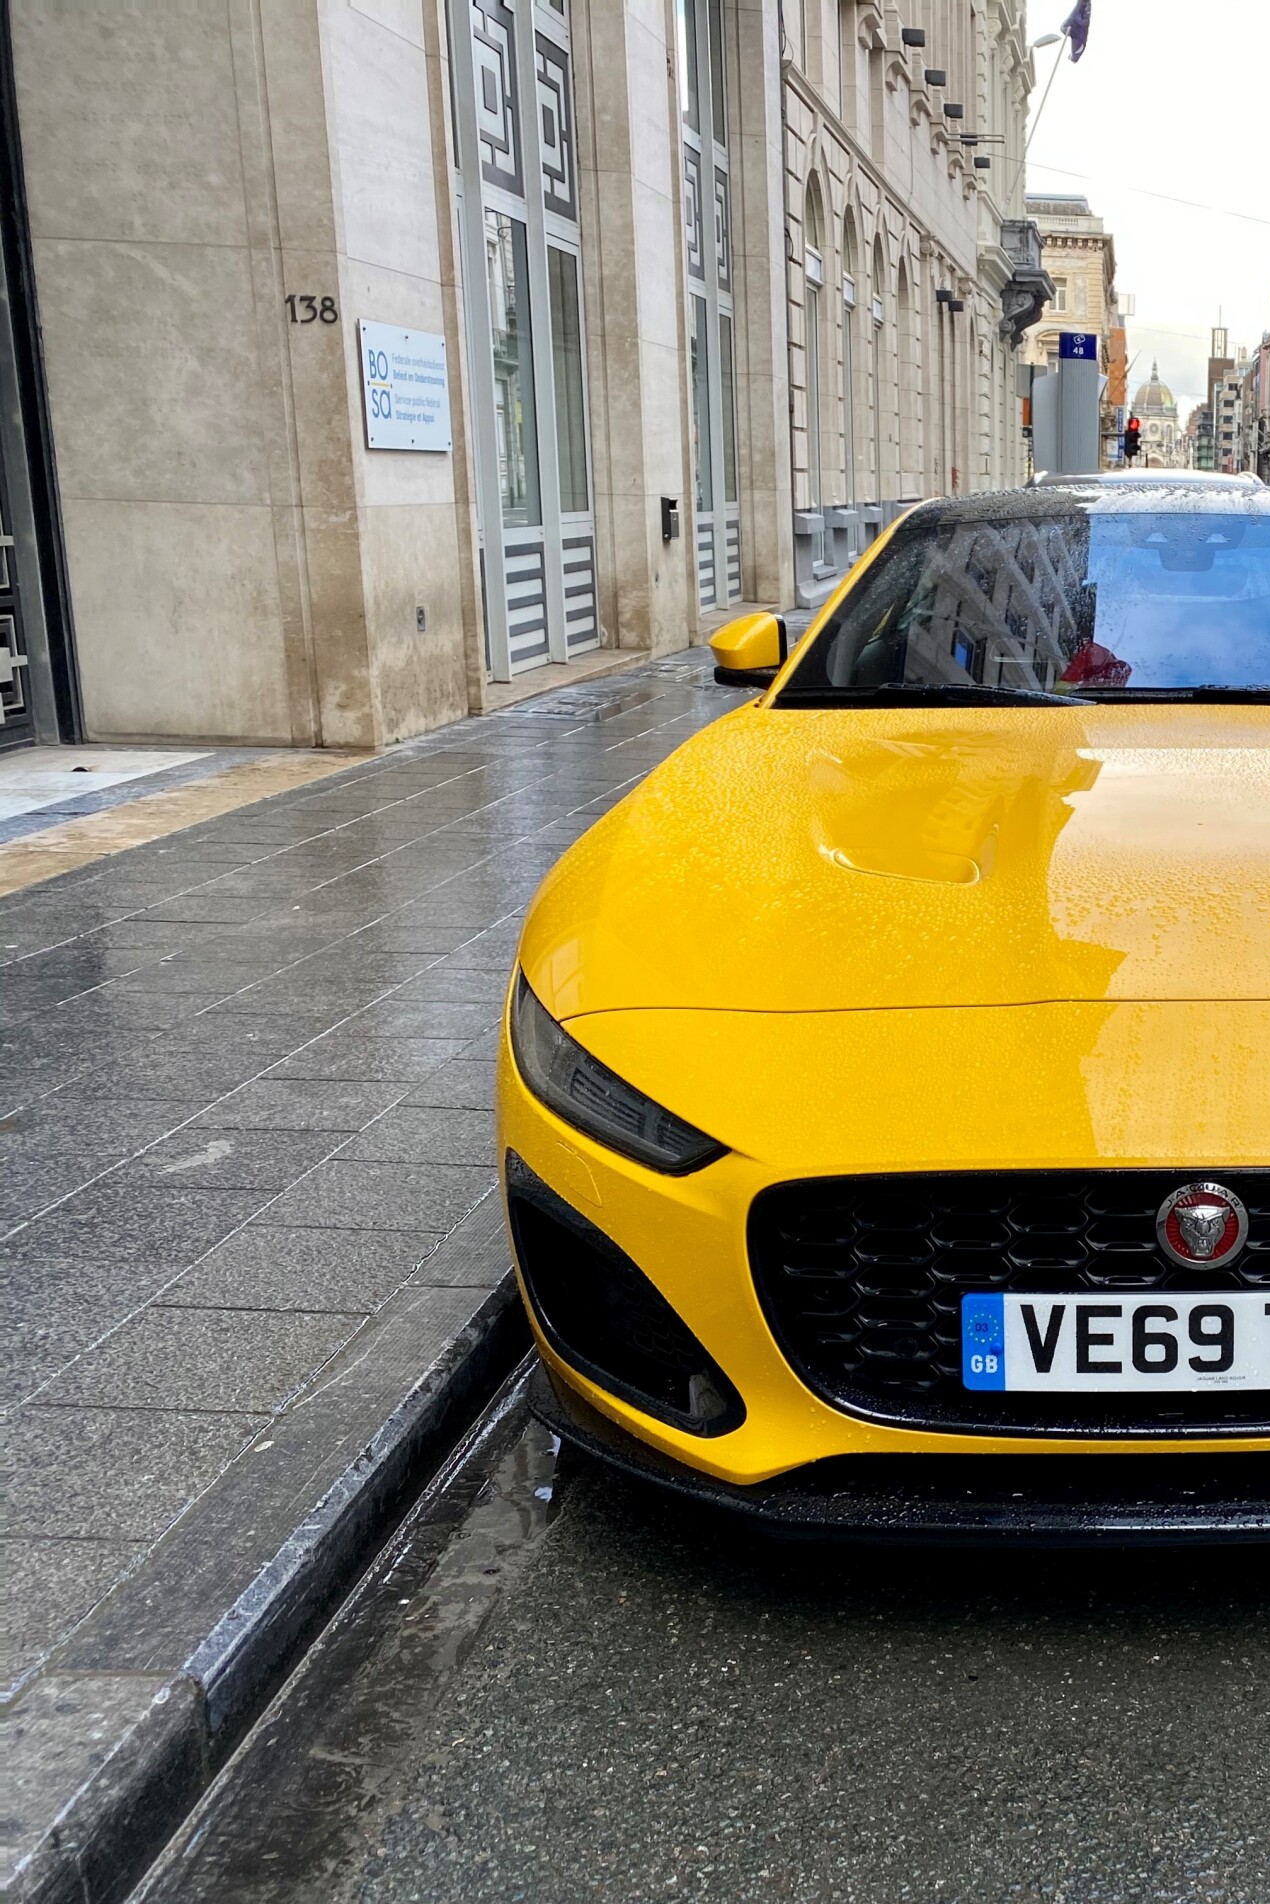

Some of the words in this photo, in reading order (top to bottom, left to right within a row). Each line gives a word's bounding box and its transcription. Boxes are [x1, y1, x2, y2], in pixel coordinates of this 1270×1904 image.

[284, 294, 339, 324] 138
[1073, 346, 1084, 355] 48
[368, 349, 389, 381] BO
[1167, 1183, 1242, 1209] JAGUAR
[1020, 1304, 1235, 1374] VE69
[970, 1354, 998, 1374] GB
